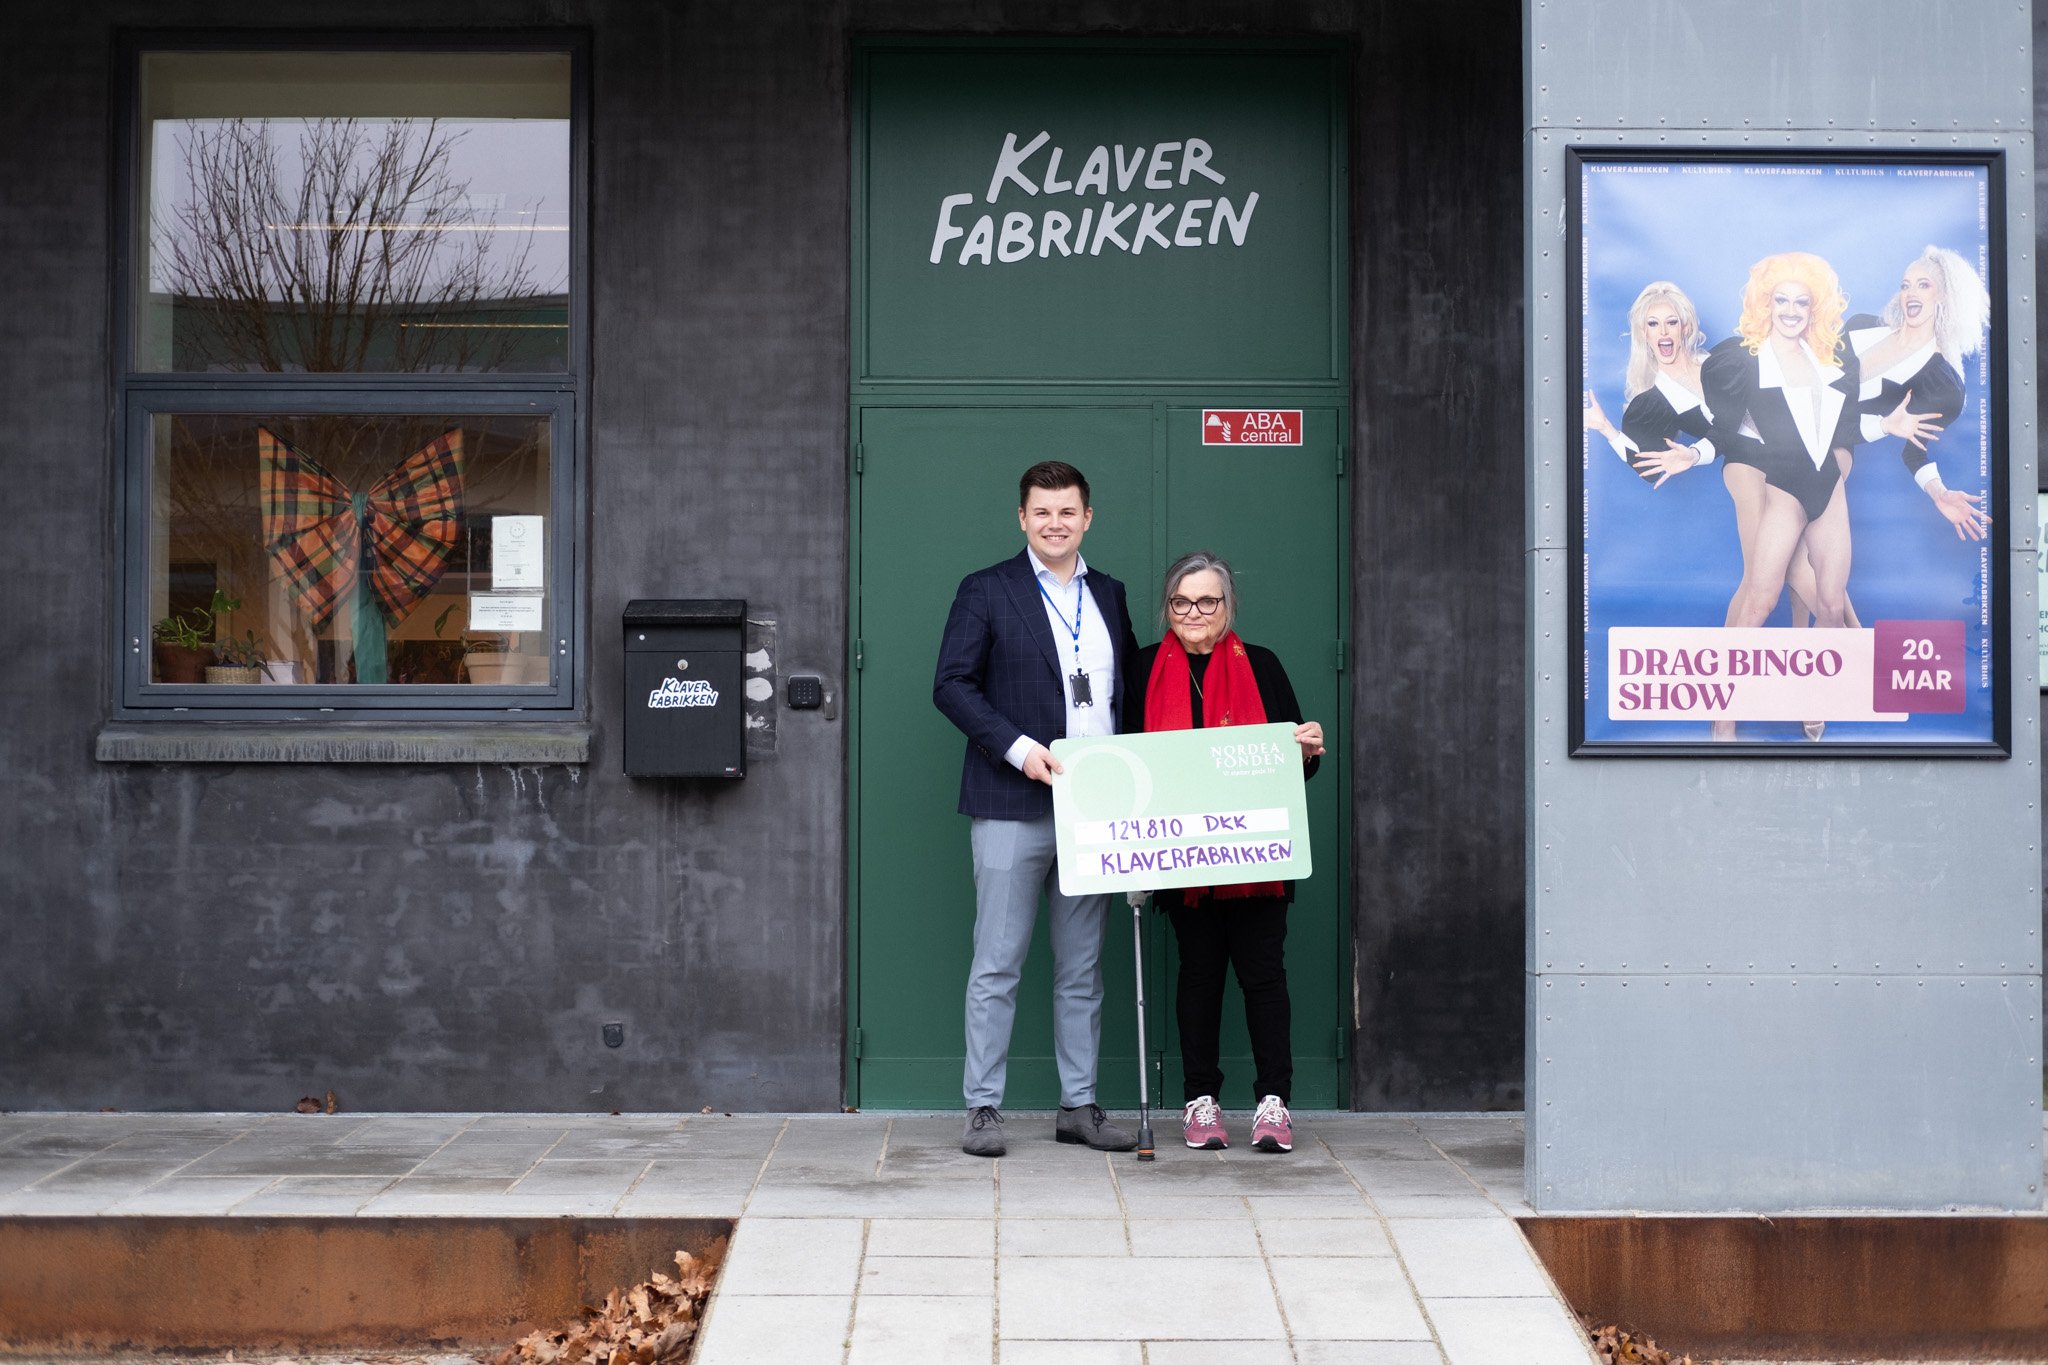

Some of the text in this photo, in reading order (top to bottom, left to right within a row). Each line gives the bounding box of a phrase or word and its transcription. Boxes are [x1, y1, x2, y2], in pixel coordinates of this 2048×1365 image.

[986, 130, 1226, 204] KLAVER
[1590, 166, 1975, 177] KLAVERFABRIKKEN KULTURHUS KLAVERFABRIKKEN KULTURHUS KLAVERFABRIKKEN
[929, 191, 1260, 266] FABRIKKEN
[1242, 413, 1286, 429] ABA
[1240, 429, 1292, 442] central
[1980, 398, 1988, 476] KLAVERFABRIKKEN
[1902, 639, 1941, 660] 20.
[1618, 648, 1843, 677] DRAG BINGO
[1981, 638, 1989, 688] KULTURHUS
[662, 680, 710, 694] KLAVER
[1891, 669, 1952, 691] MAR
[650, 692, 717, 706] FABRIKKEN
[1618, 682, 1736, 711] SHOW
[1210, 742, 1280, 757] NORDEA
[1216, 753, 1285, 768] FONDEN
[1108, 814, 1247, 841] 124.810 DKK
[1101, 840, 1292, 875] KLAVERFABRIKKEN
